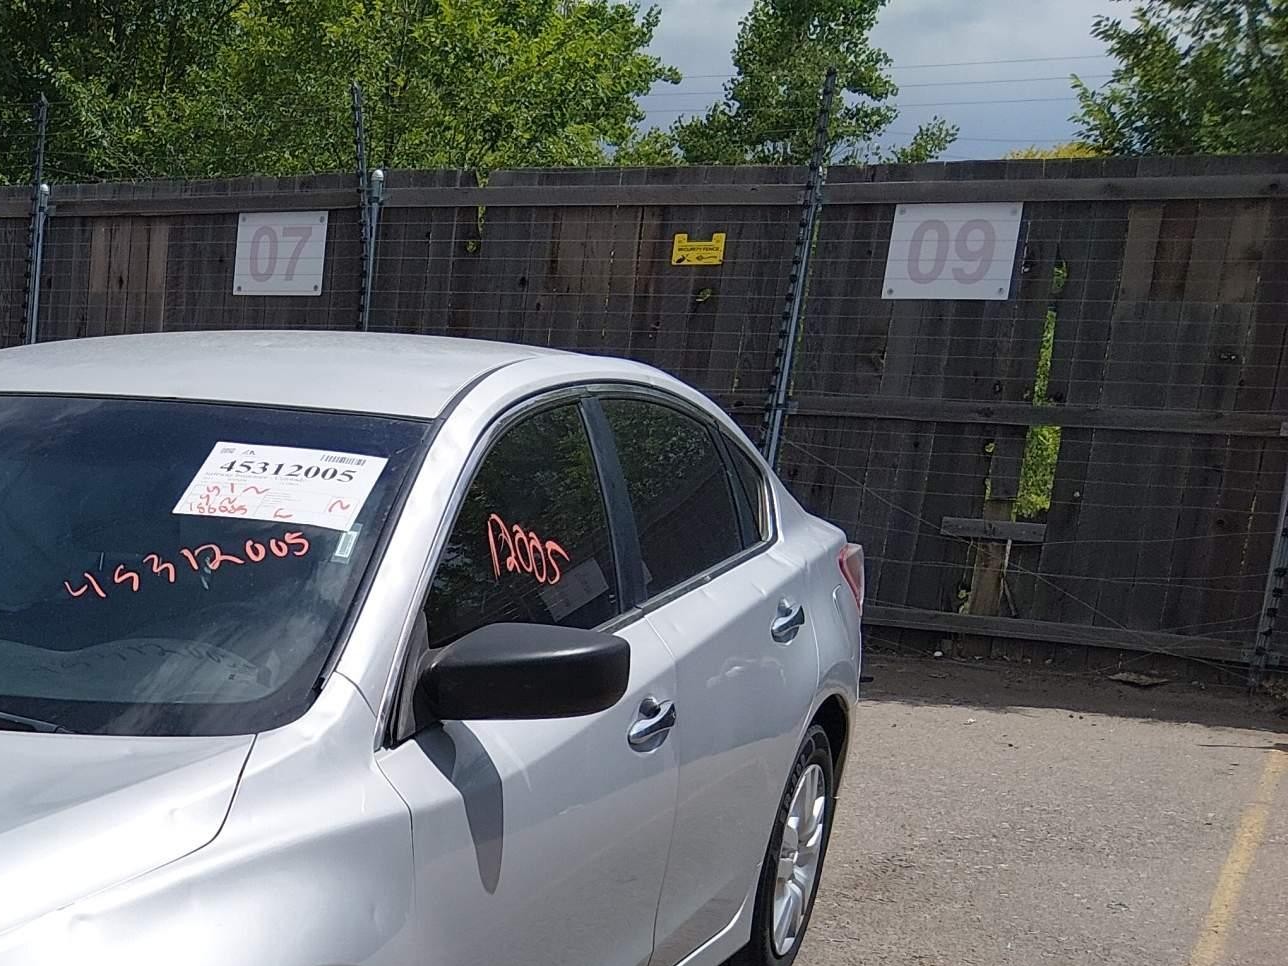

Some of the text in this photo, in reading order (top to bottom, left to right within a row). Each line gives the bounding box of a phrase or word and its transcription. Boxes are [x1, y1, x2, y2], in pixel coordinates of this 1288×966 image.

[249, 225, 312, 282] 07
[907, 218, 996, 285] 09
[220, 458, 358, 483] 45312005
[64, 531, 310, 598] 45312005
[487, 513, 570, 585] 12005
